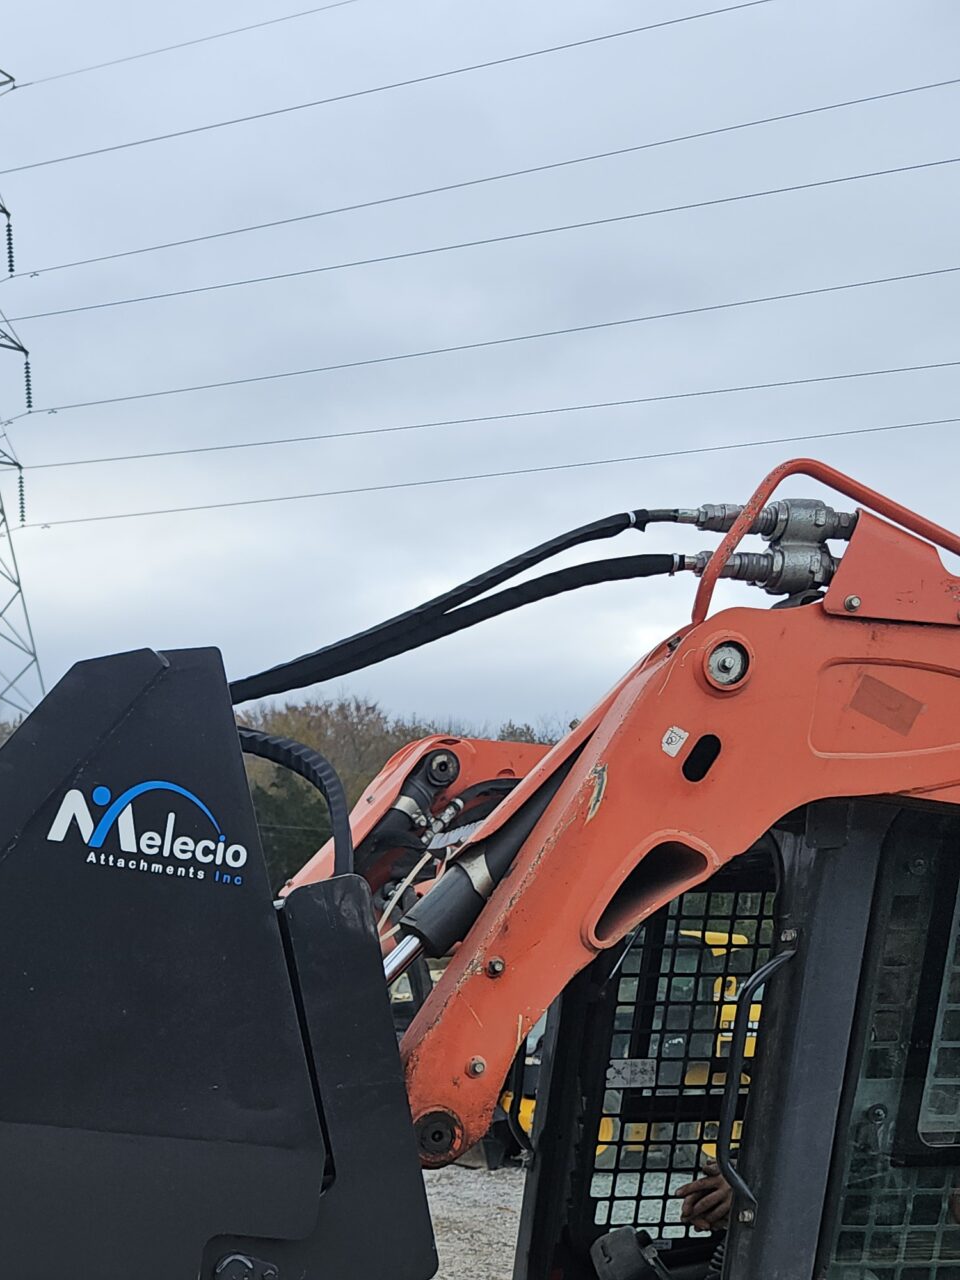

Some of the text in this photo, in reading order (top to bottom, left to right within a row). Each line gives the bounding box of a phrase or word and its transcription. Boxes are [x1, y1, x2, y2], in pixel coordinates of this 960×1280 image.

[46, 780, 248, 868] Melecio
[85, 850, 243, 885] Attachments Inc
